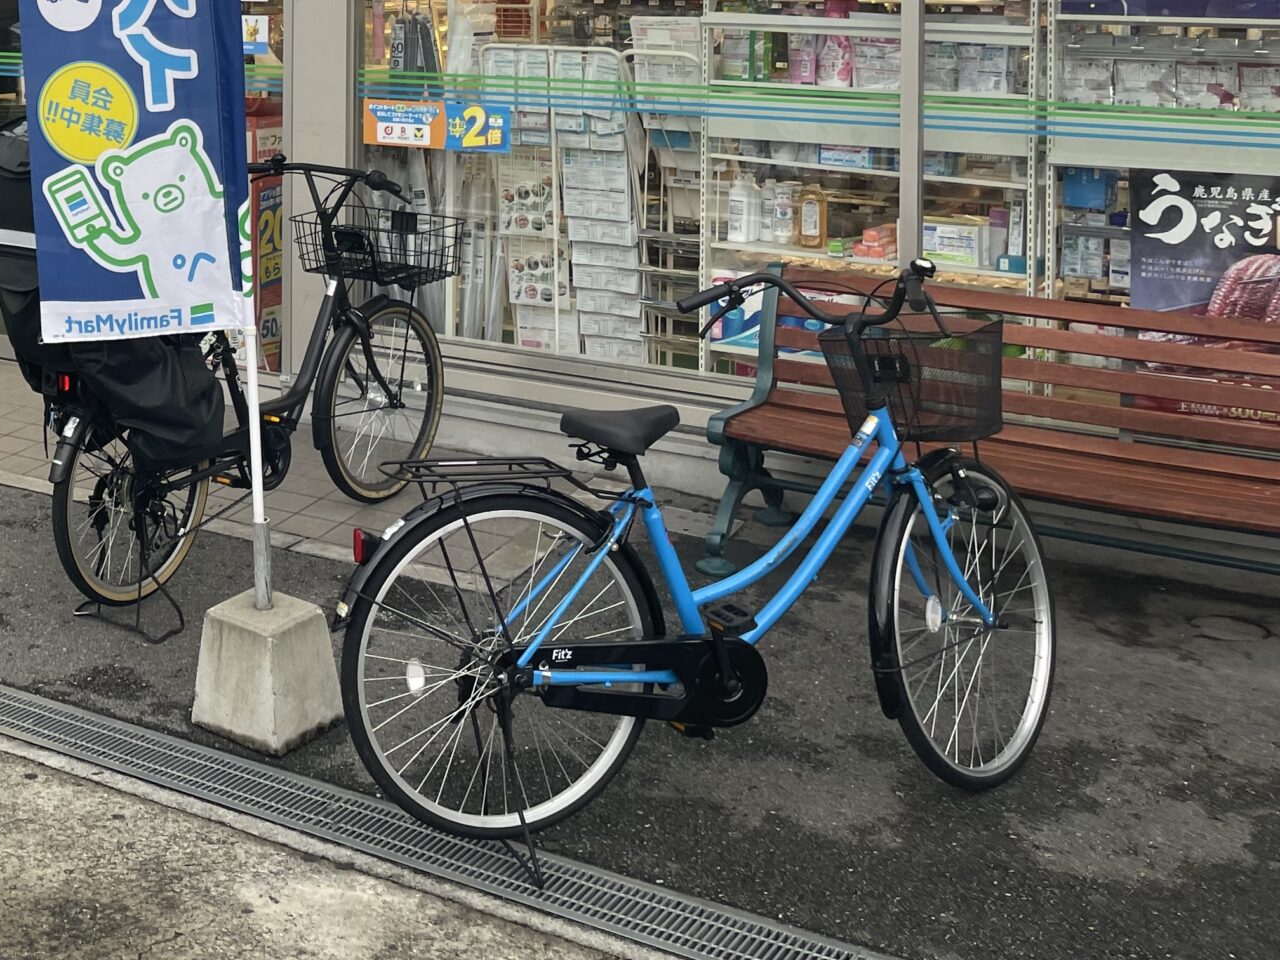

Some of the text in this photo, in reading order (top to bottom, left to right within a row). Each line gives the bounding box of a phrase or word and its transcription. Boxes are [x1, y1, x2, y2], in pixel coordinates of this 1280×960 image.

[1139, 173, 1274, 249] うなぎ
[1192, 184, 1272, 201] 鹿児島県産
